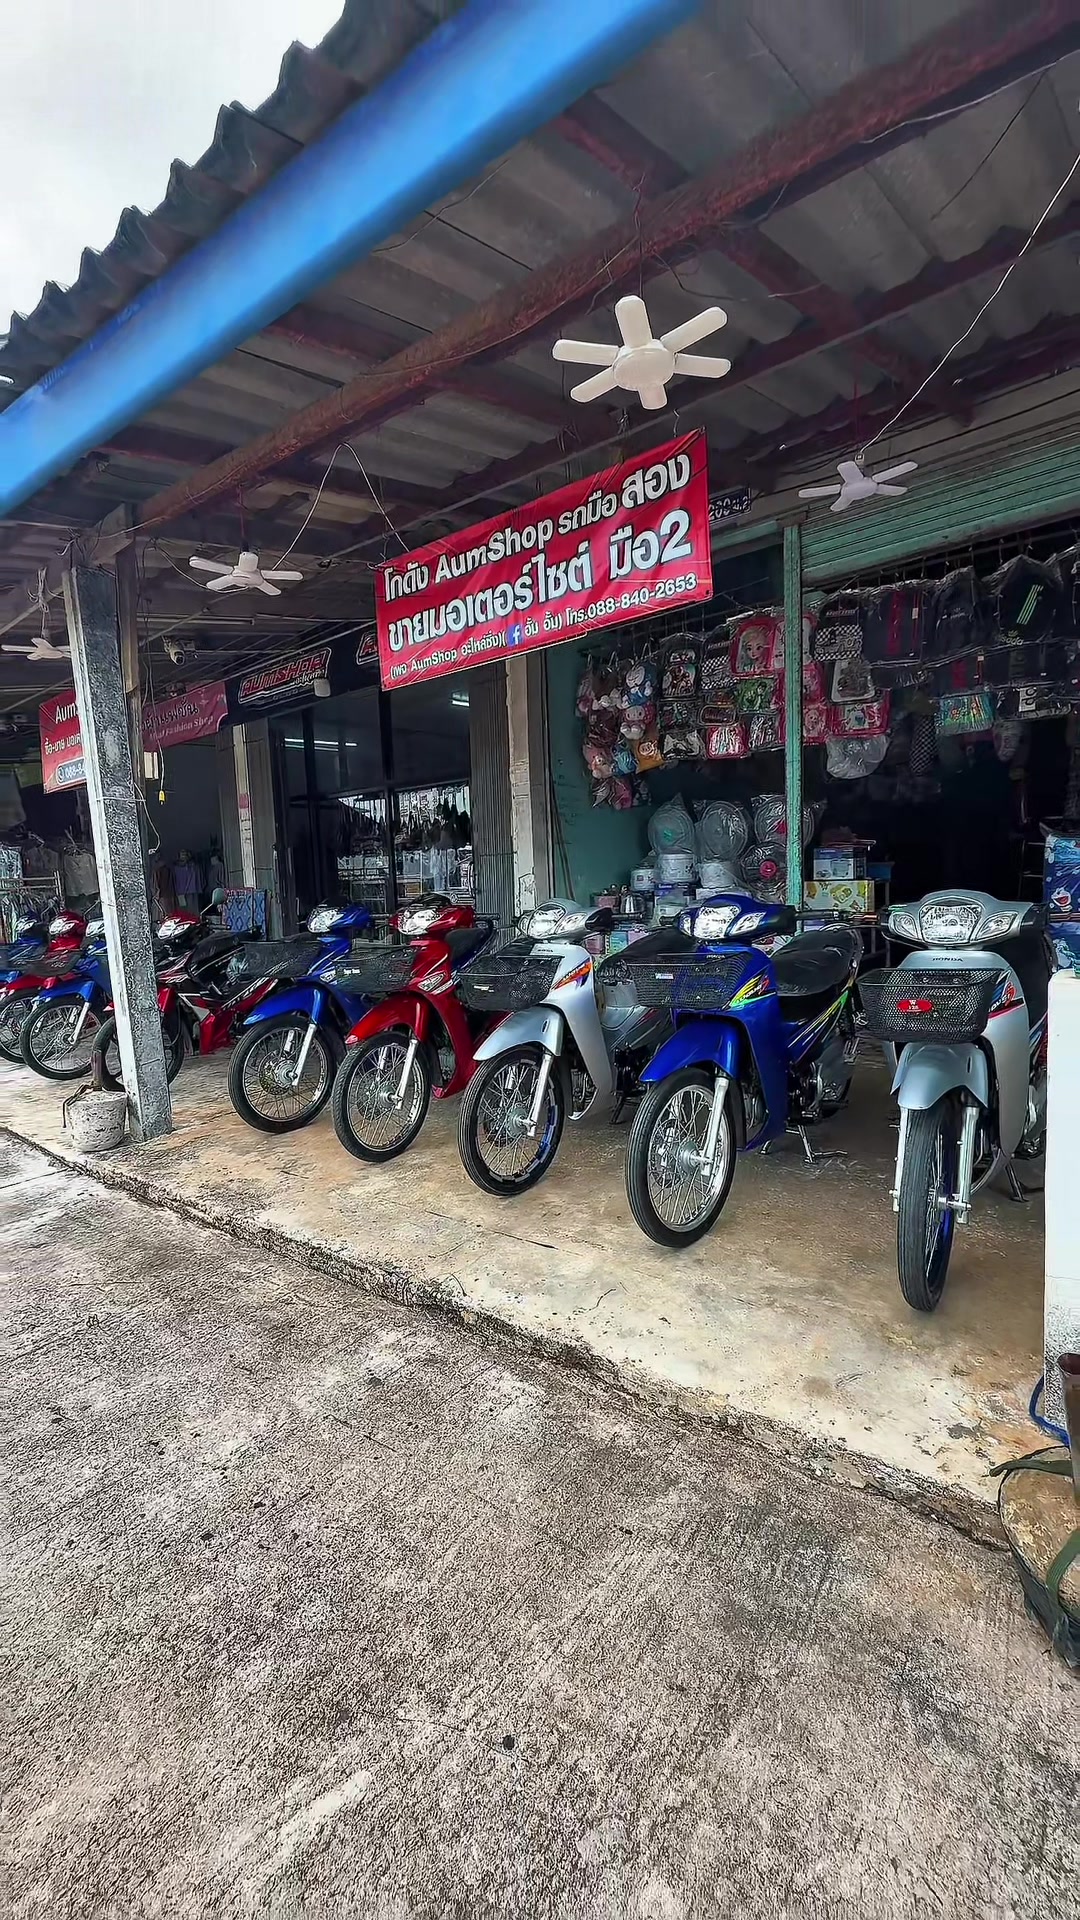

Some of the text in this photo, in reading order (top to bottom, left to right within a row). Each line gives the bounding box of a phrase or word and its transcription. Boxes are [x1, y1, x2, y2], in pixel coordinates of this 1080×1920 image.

[384, 454, 691, 602] โกดัง AumShop รถมือ สอง
[609, 509, 692, 579] มือ2
[410, 648, 458, 672] AumShop
[565, 572, 697, 627] โทร.088-840-2653
